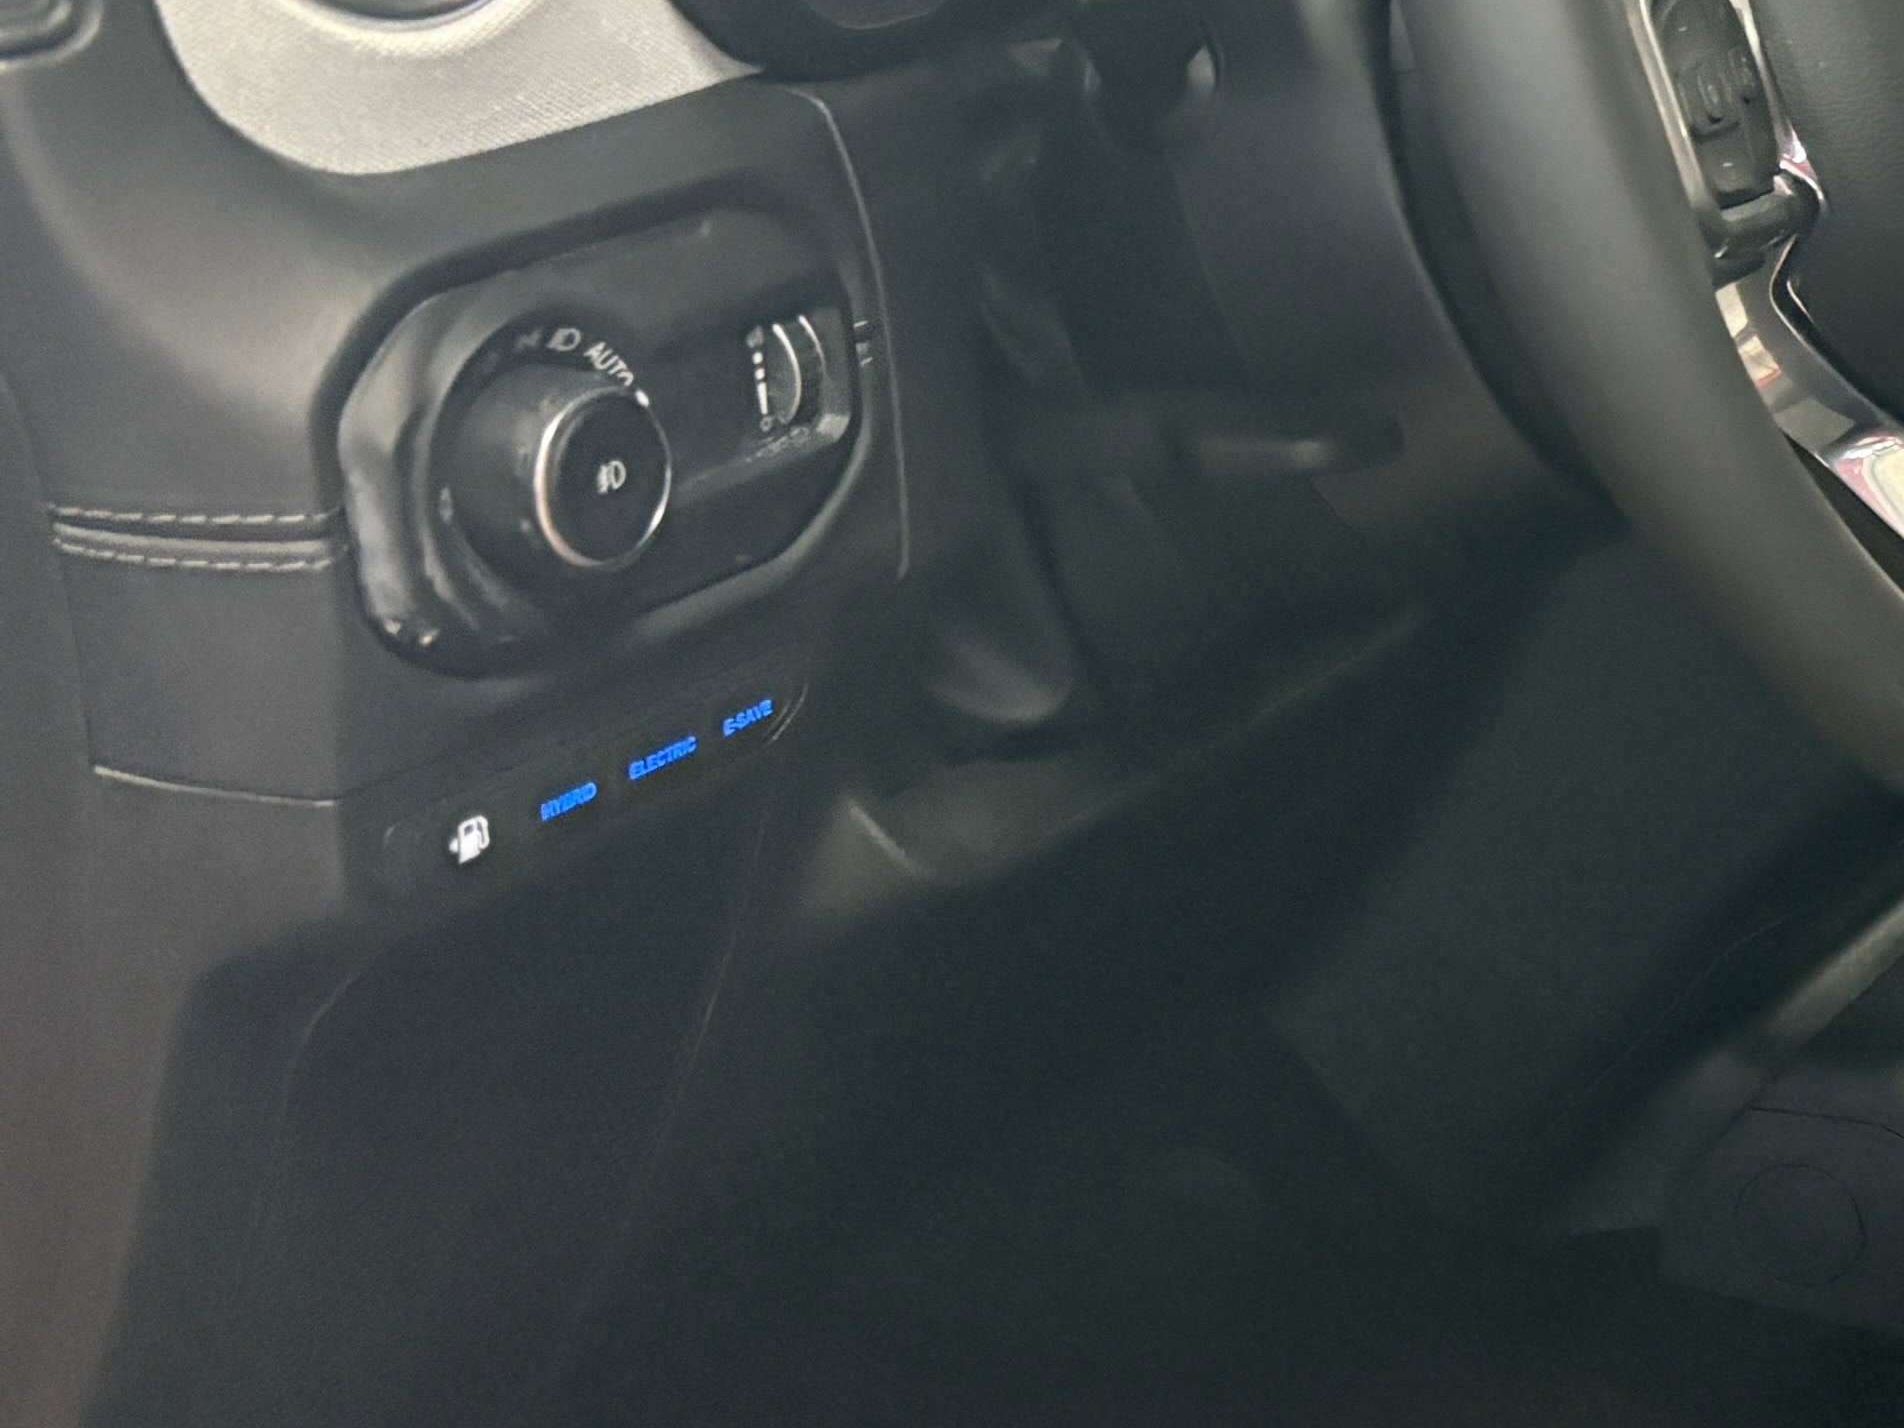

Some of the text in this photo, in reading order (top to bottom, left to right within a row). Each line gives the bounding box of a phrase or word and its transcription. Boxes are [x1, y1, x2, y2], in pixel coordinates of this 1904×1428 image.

[583, 341, 635, 388] AUTO
[540, 698, 774, 822] HYBRID ELECTRIC E-SAVE
